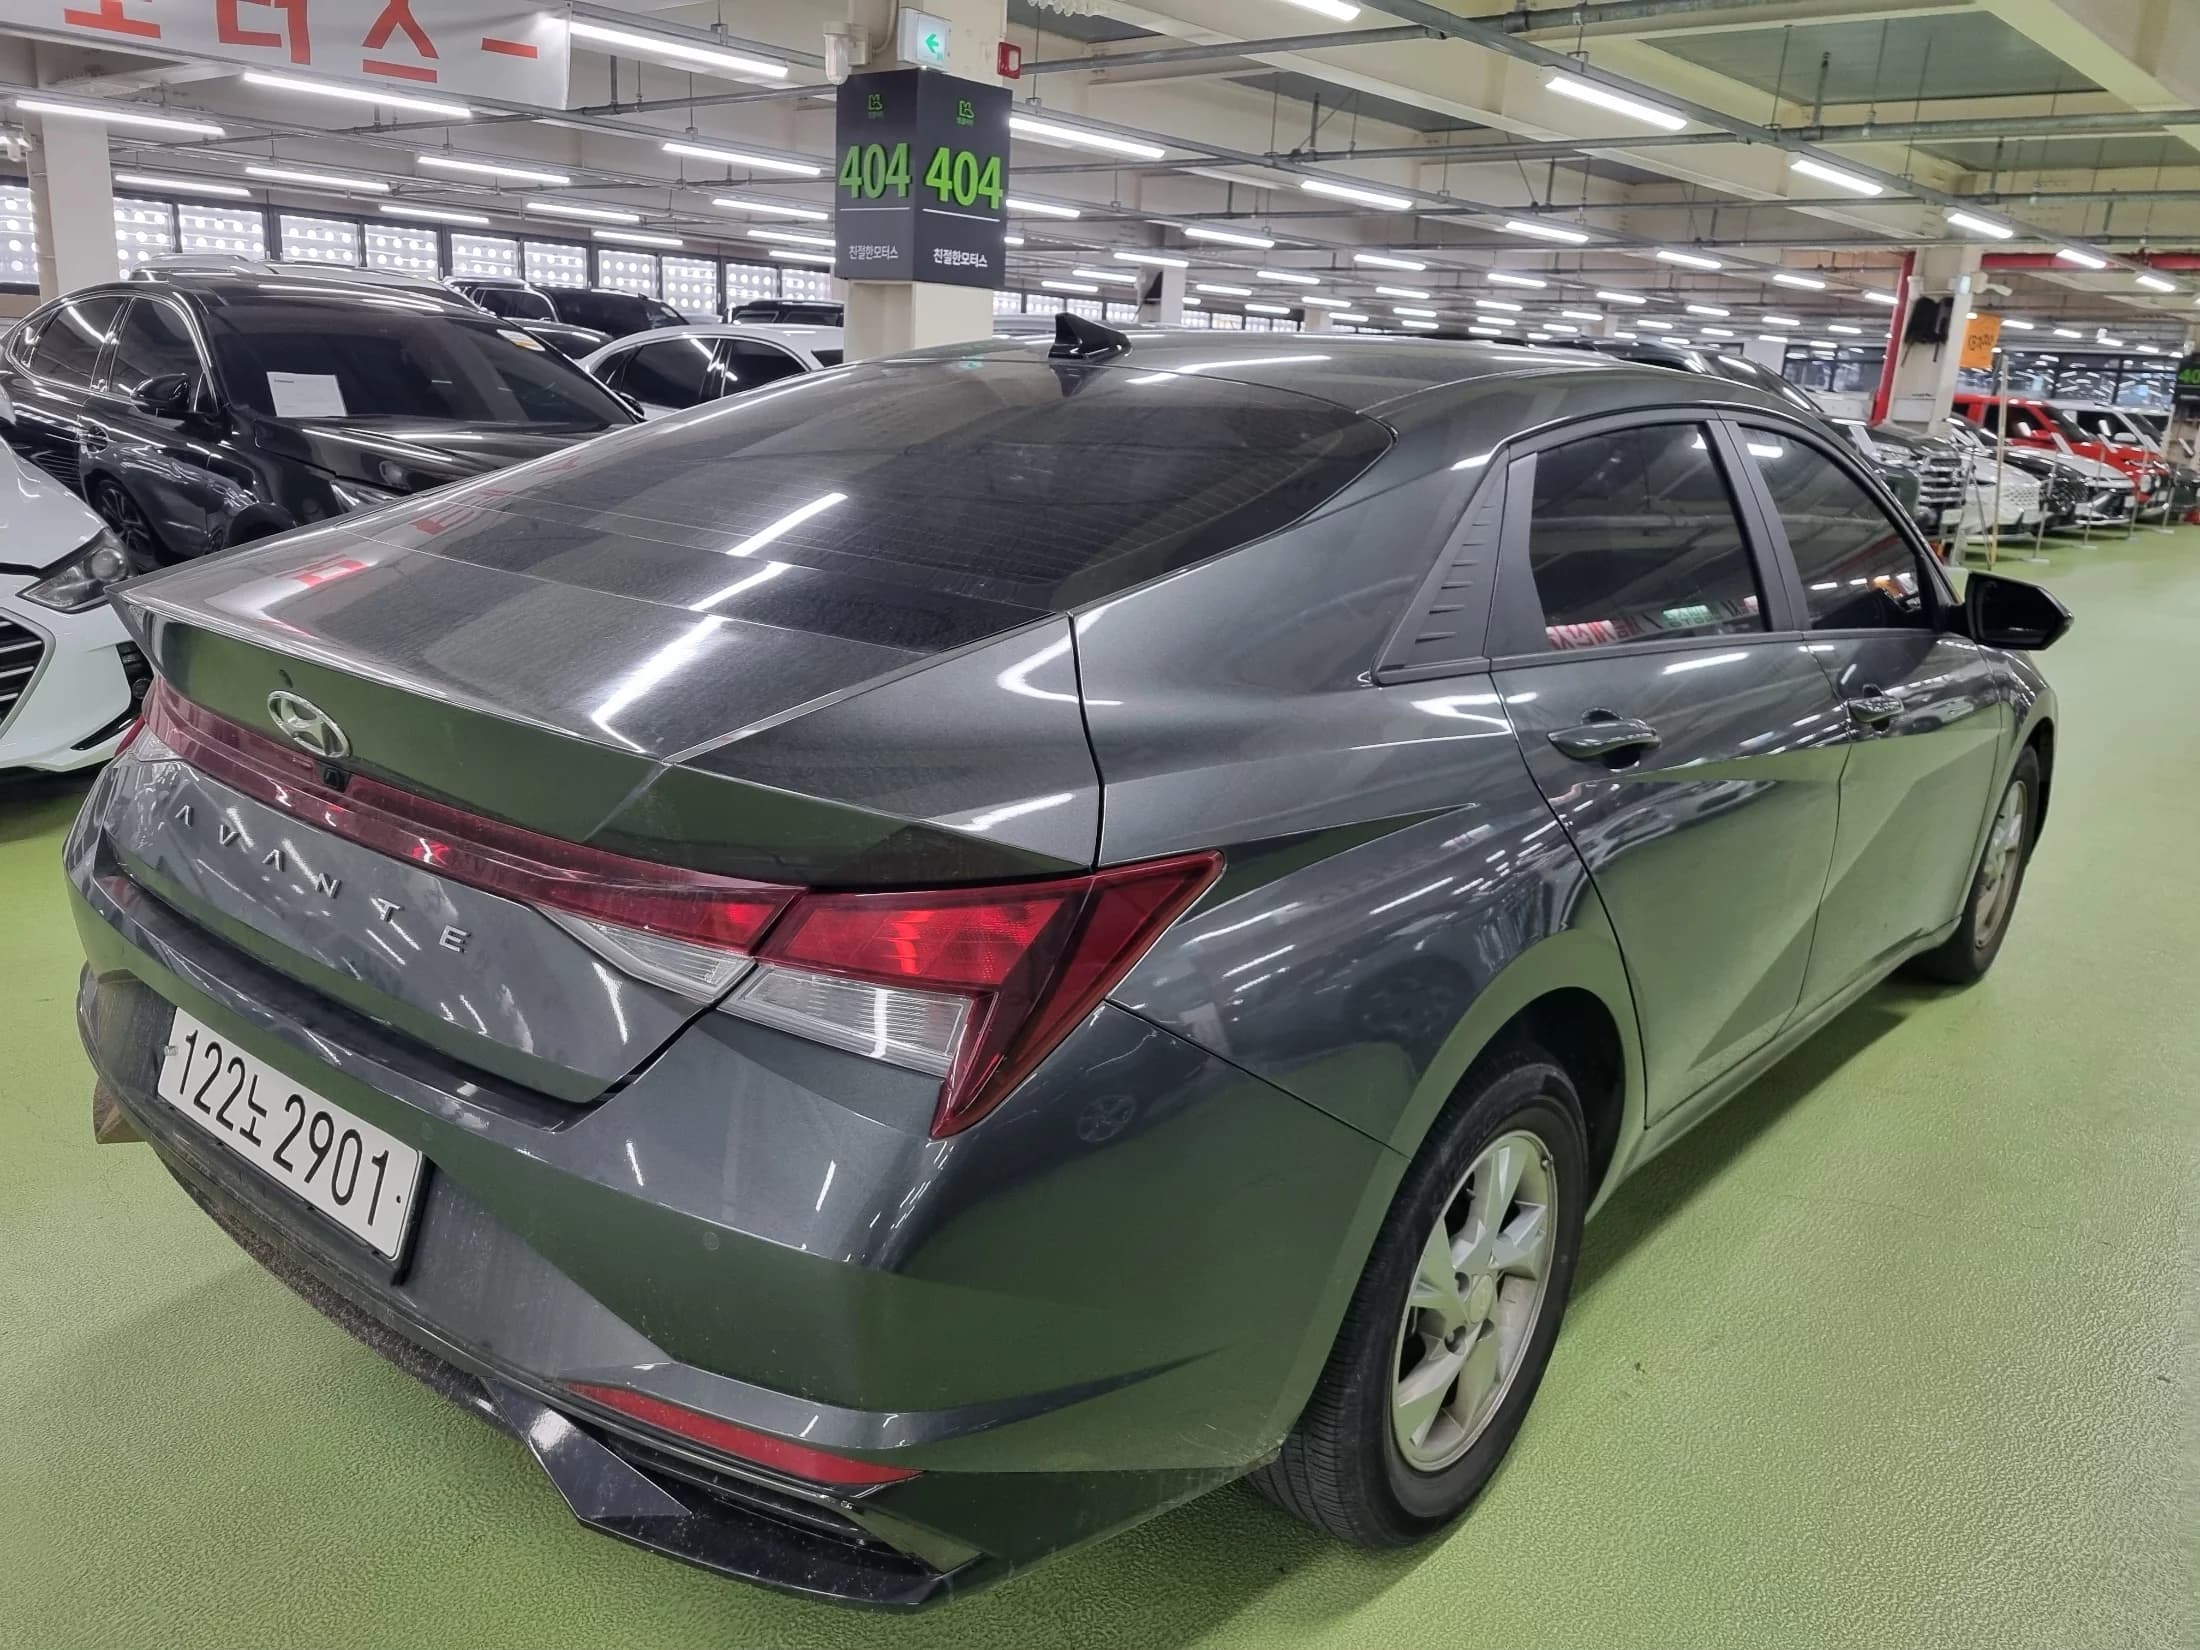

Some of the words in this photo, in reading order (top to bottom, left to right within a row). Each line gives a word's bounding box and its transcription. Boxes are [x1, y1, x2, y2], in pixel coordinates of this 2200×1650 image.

[839, 143, 910, 199] 404
[925, 147, 1003, 210] 404
[848, 244, 899, 260] 친절한모터스
[933, 247, 988, 268] 친절한모터스
[175, 804, 471, 952] AVANTE
[180, 1029, 267, 1147] 122노
[273, 1094, 389, 1226] 2901
